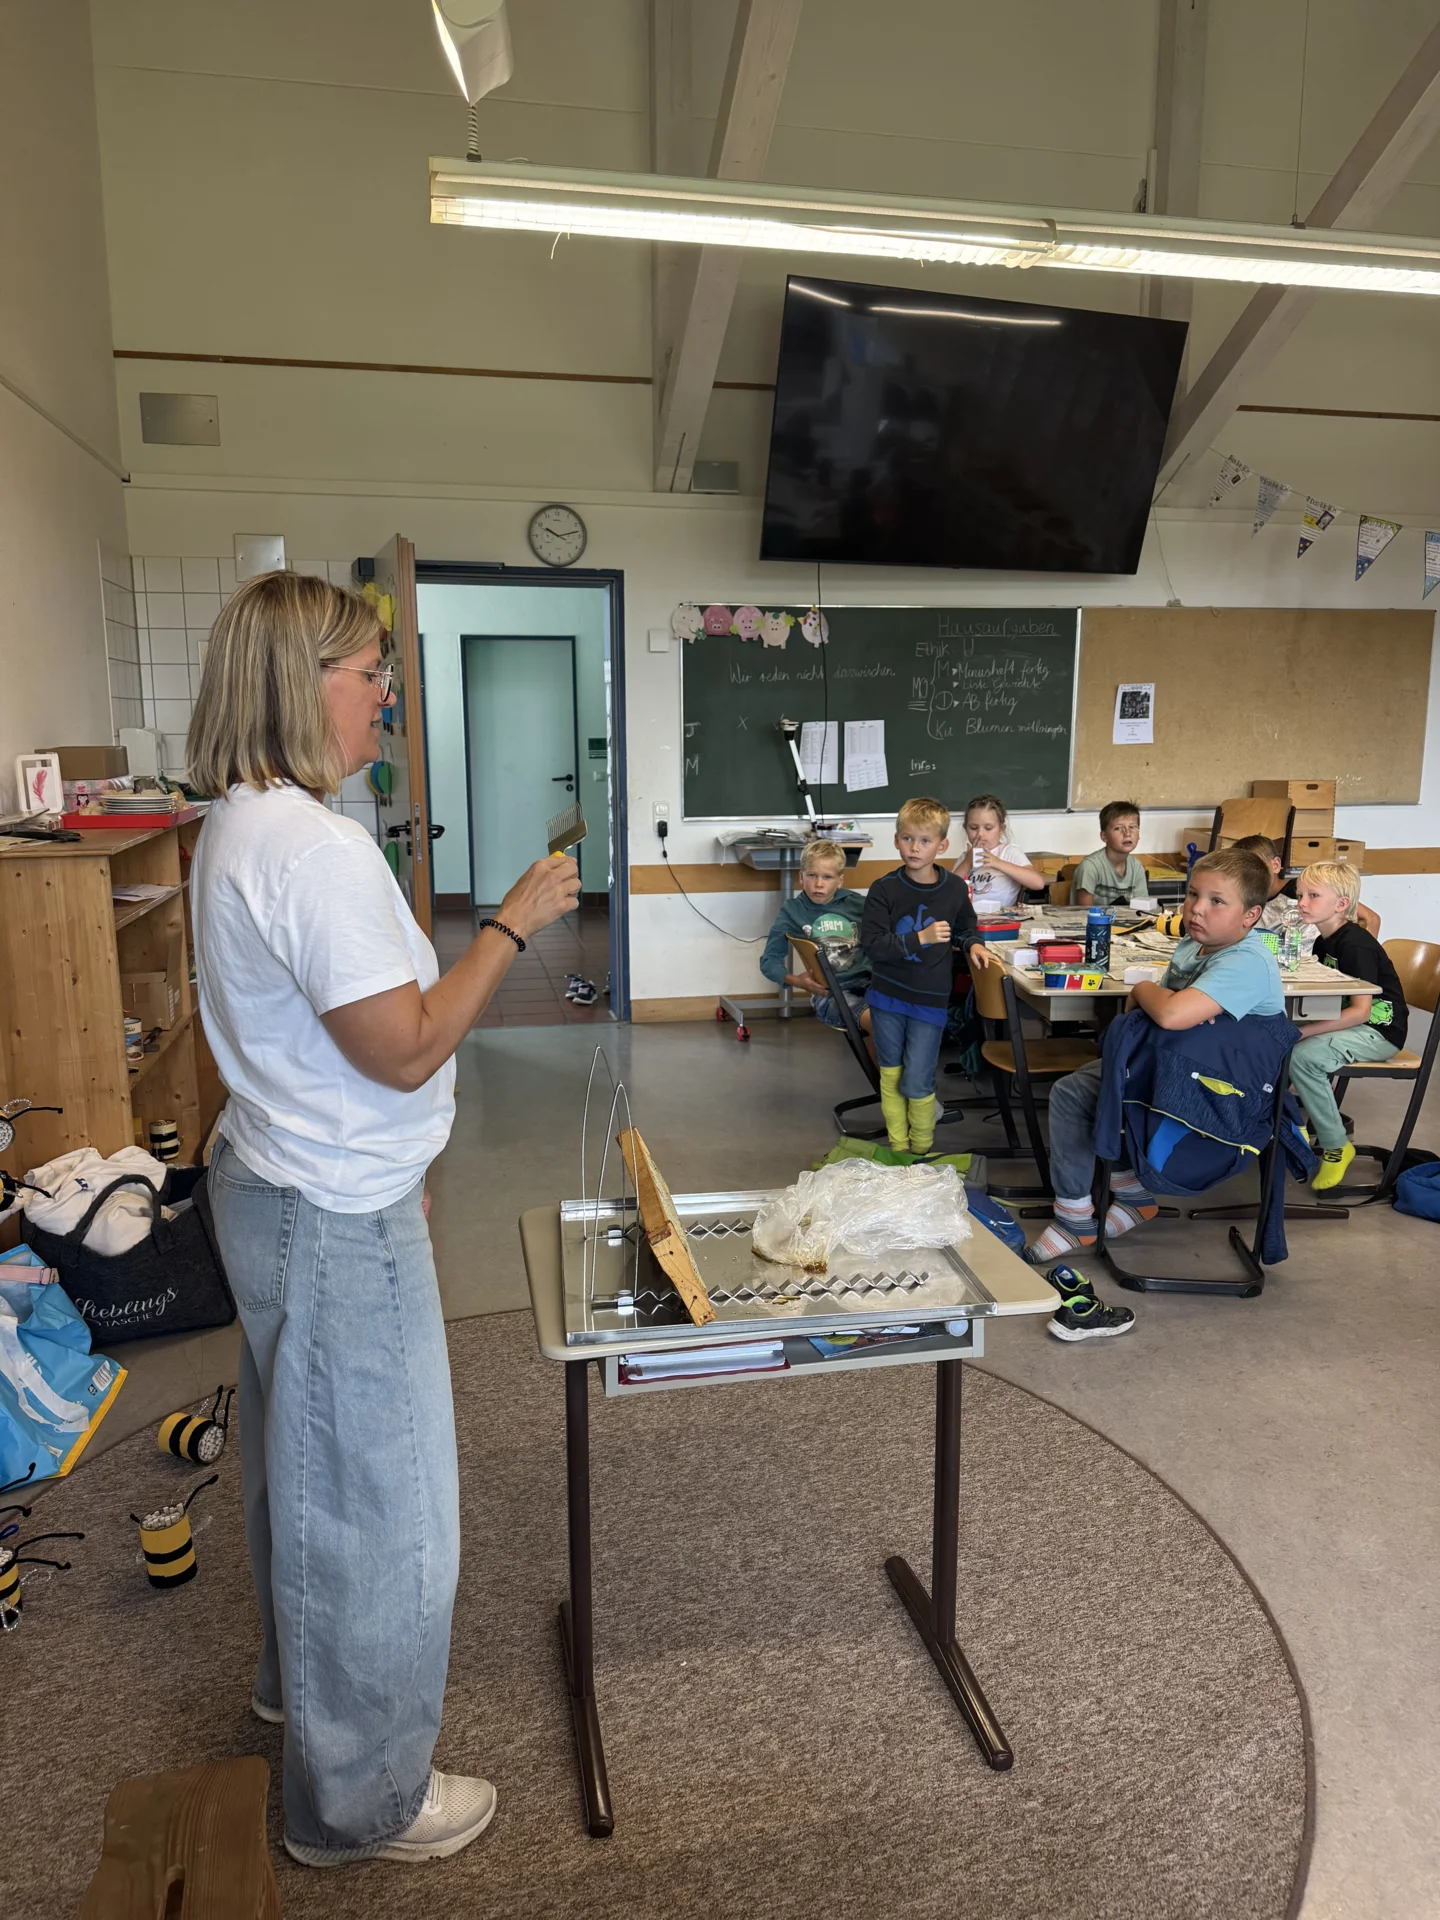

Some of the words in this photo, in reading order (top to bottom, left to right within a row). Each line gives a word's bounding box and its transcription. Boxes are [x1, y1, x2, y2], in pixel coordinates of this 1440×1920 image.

[938, 614, 1057, 638] Hausaufgaben
[915, 641, 950, 657] Ethik
[730, 662, 752, 684] Wir
[759, 666, 790, 682] reden
[796, 664, 824, 681] nicht
[1020, 658, 1050, 681] fertig
[962, 692, 981, 711] AB
[985, 691, 1018, 715] fertig
[966, 717, 1014, 735] Blumen
[685, 754, 699, 778] M
[911, 759, 936, 771] Info:
[75, 1287, 179, 1318] Lieblings
[104, 1312, 152, 1327] TASCHE
